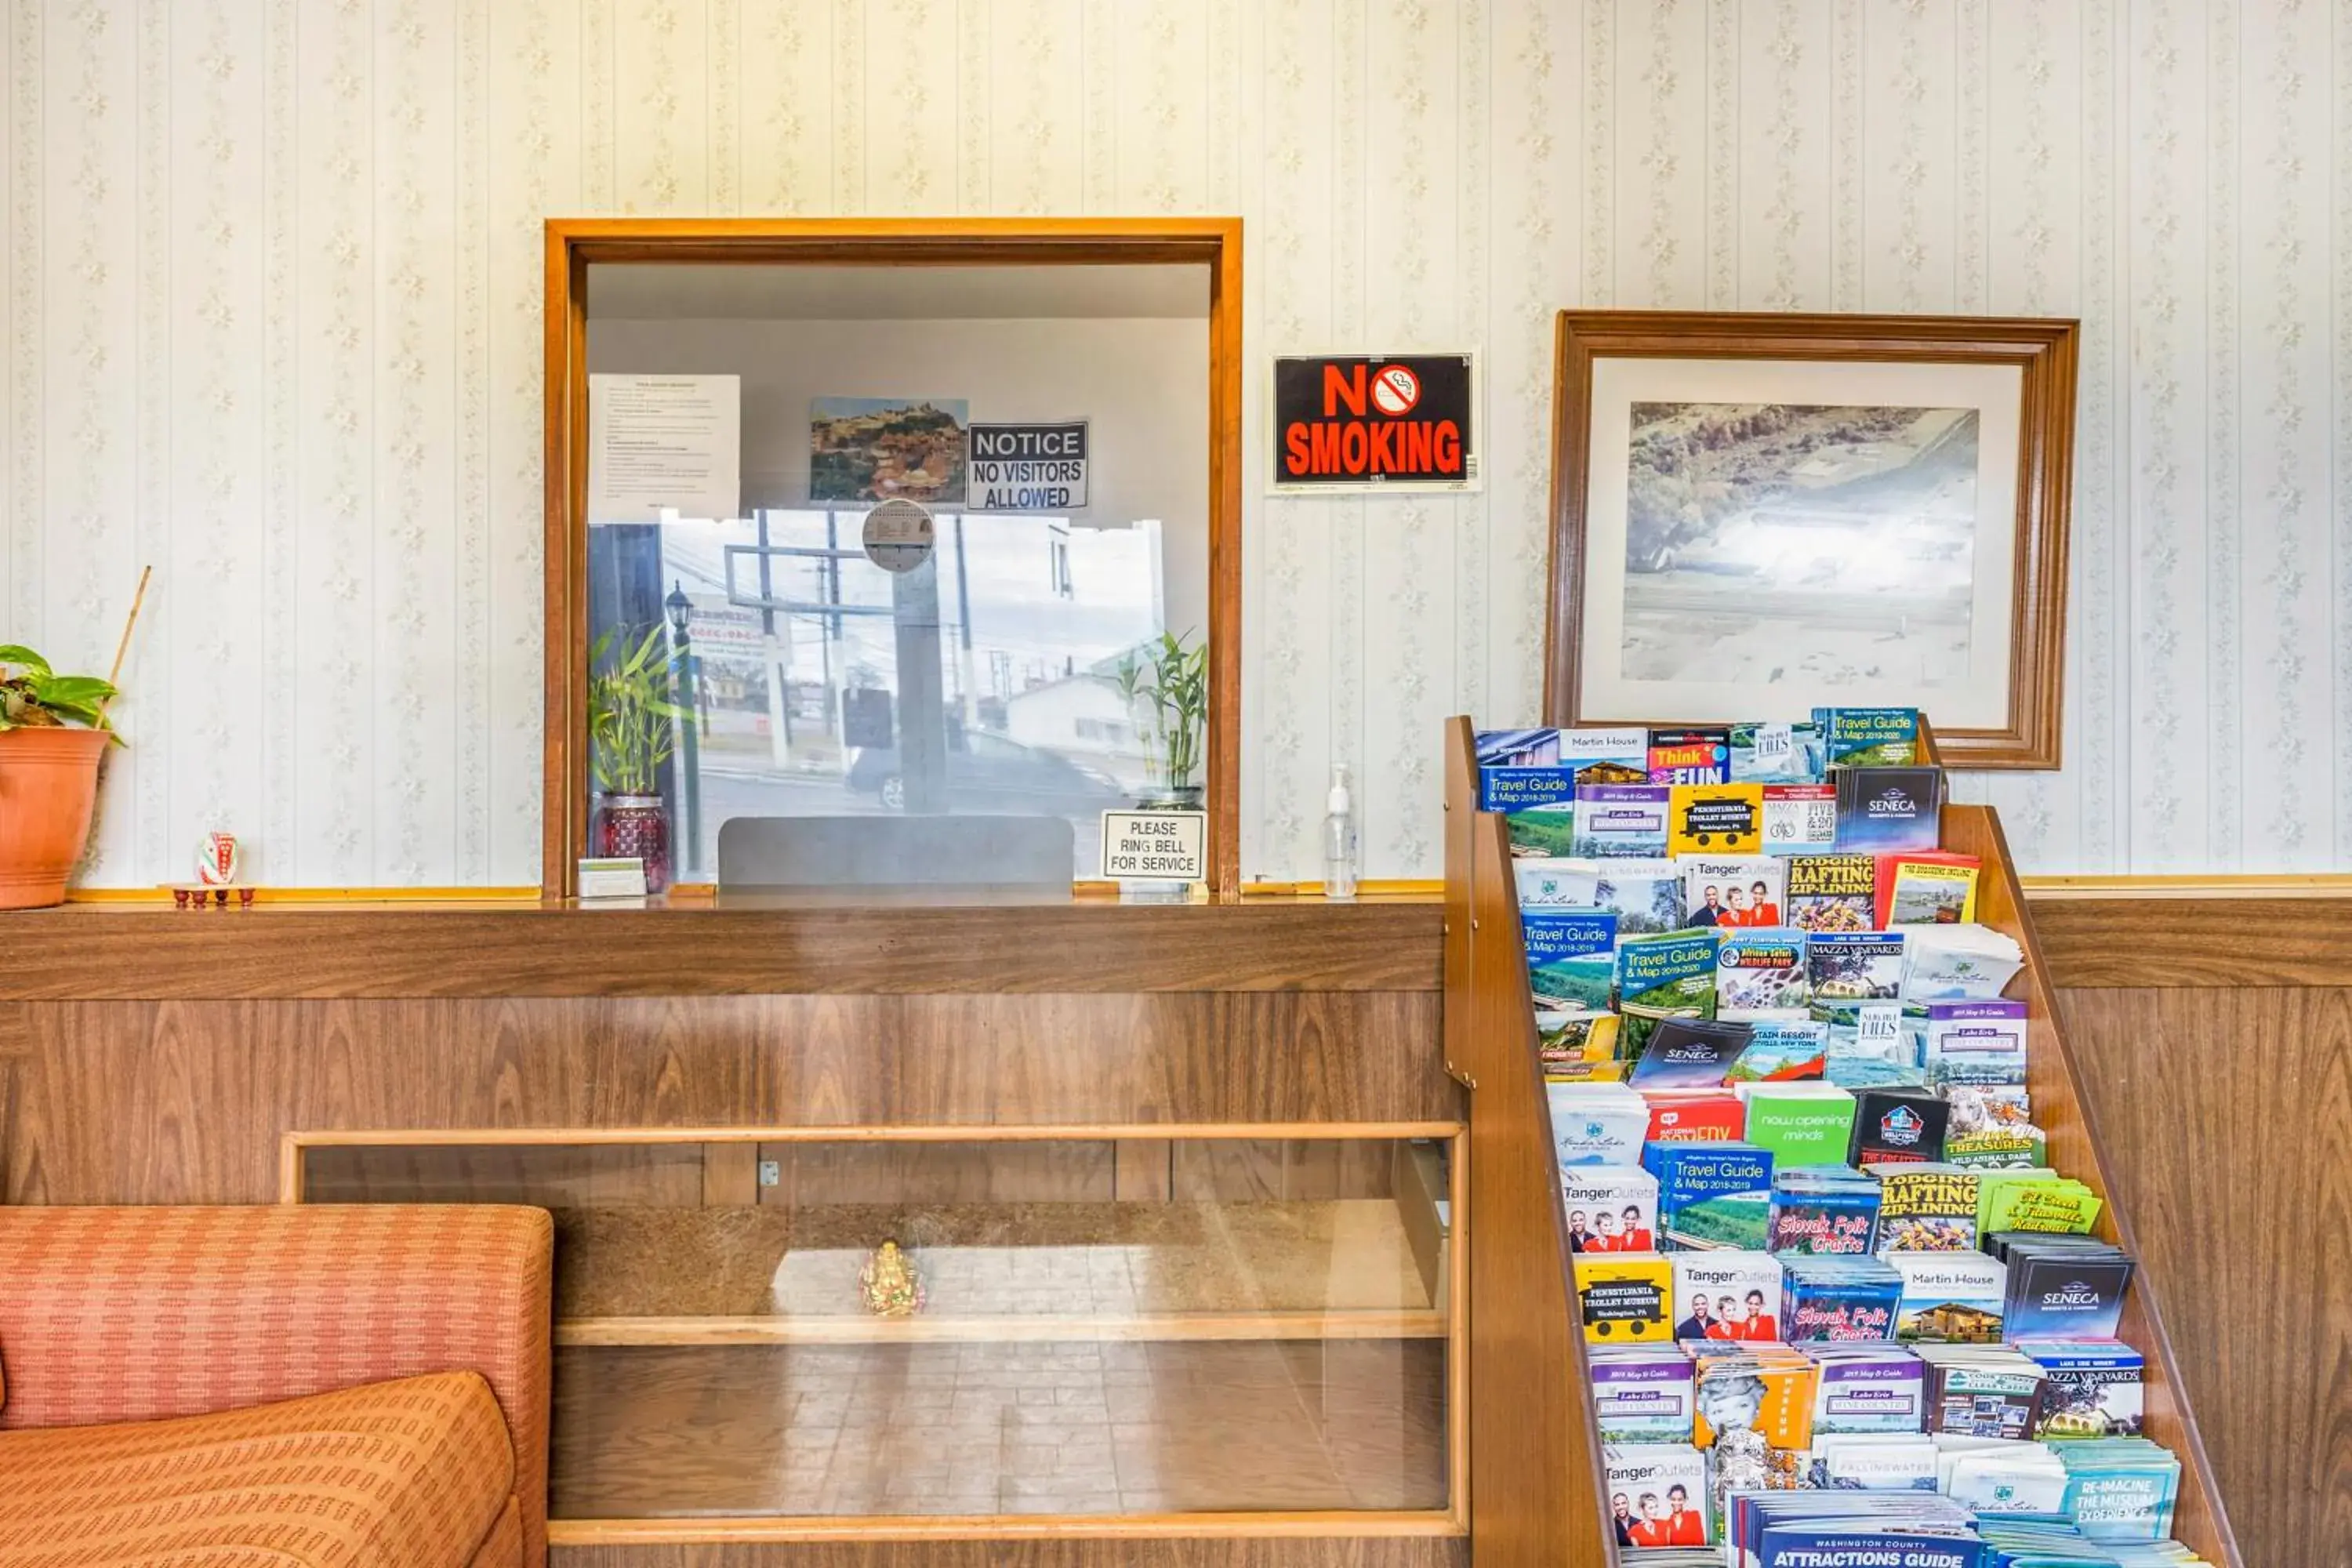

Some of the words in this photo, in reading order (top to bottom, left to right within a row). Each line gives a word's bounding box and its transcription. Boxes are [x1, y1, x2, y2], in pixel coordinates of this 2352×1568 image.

[977, 433, 1080, 455] NOTICE
[1287, 420, 1460, 475] SMOKING
[975, 463, 999, 483] NO
[1004, 462, 1081, 482] VISITORS
[985, 488, 1069, 508] ALLOWED
[1835, 717, 1871, 728] Travel
[1875, 717, 1911, 728] Guide
[1845, 731, 1863, 739] Map
[1573, 737, 1604, 747] Martin
[1606, 736, 1638, 746] House
[1657, 751, 1701, 765] Think
[1675, 768, 1722, 784] FUN
[1490, 779, 1526, 791] Travel
[1529, 779, 1567, 791] Guide
[1490, 793, 1497, 802] &
[1499, 793, 1519, 803] Map
[1868, 800, 1915, 811] SENECA
[1131, 822, 1177, 835] PLEASE
[1120, 839, 1150, 852] RING
[1155, 840, 1186, 853] BELL
[1111, 856, 1136, 869] FOR
[1142, 856, 1195, 871] SERVICE
[1792, 857, 1873, 866] LODGING
[1791, 867, 1873, 883] RAFTING
[1790, 884, 1873, 894] ZIP-LINING
[1524, 927, 1563, 940] Travel
[1567, 928, 1607, 940] Guide
[1533, 942, 1555, 953] Map
[1740, 948, 1768, 957] African
[1770, 948, 1791, 957] Safari
[1849, 945, 1903, 955] VINEYARDS
[1627, 952, 1666, 966] Travel
[1671, 948, 1711, 962] Guide
[1740, 957, 1770, 966] WILDLIFE
[1773, 957, 1793, 967] PARK
[1626, 969, 1634, 978] &
[1637, 967, 1660, 978] Map
[1667, 1049, 1718, 1058] SENECA
[1762, 1116, 1793, 1125] now
[1795, 1114, 1850, 1128] opening
[1784, 1129, 1824, 1141] minds
[1947, 1139, 2032, 1152] TREASURES
[1950, 1156, 1971, 1165] WILD
[1973, 1153, 2006, 1162] ANIMAL
[1675, 1162, 1715, 1176] Travel
[1720, 1163, 1763, 1178] Guide
[1675, 1178, 1682, 1189] &
[1686, 1178, 1708, 1190] Map
[1710, 1180, 1751, 1189] 2018-2019
[1882, 1174, 1979, 1185] LODGING
[1882, 1185, 1978, 1204] RAFTING
[1881, 1203, 1976, 1216] ZIP-LINING
[1778, 1214, 1831, 1234] Slovak
[1835, 1215, 1868, 1235] Folk
[1813, 1233, 1864, 1254] Crafts
[1912, 1274, 1951, 1284] Martin
[1955, 1274, 1994, 1284] House
[1591, 1287, 1653, 1297] PENNSYLVANIA
[1585, 1298, 1622, 1308] TROLLEY
[1623, 1296, 1659, 1306] MUSEUM
[2042, 1293, 2100, 1304] SENECA
[1795, 1307, 1849, 1325] Slovak
[1853, 1308, 1888, 1326] Folk
[1832, 1328, 1883, 1341] Crafts
[2049, 1373, 2078, 1382] AZZA
[2079, 1372, 2139, 1383] VINEYARDS
[2082, 1480, 2152, 1494] RE-IMAGINE
[2078, 1497, 2098, 1508] THE
[2100, 1494, 2154, 1508] MUSEUM
[2078, 1508, 2149, 1520] EXPERIENCE
[1886, 1541, 1926, 1549] COUNTY
[1774, 1552, 1900, 1568] ATTRACTIONS
[1904, 1553, 1964, 1568] GUIDE
